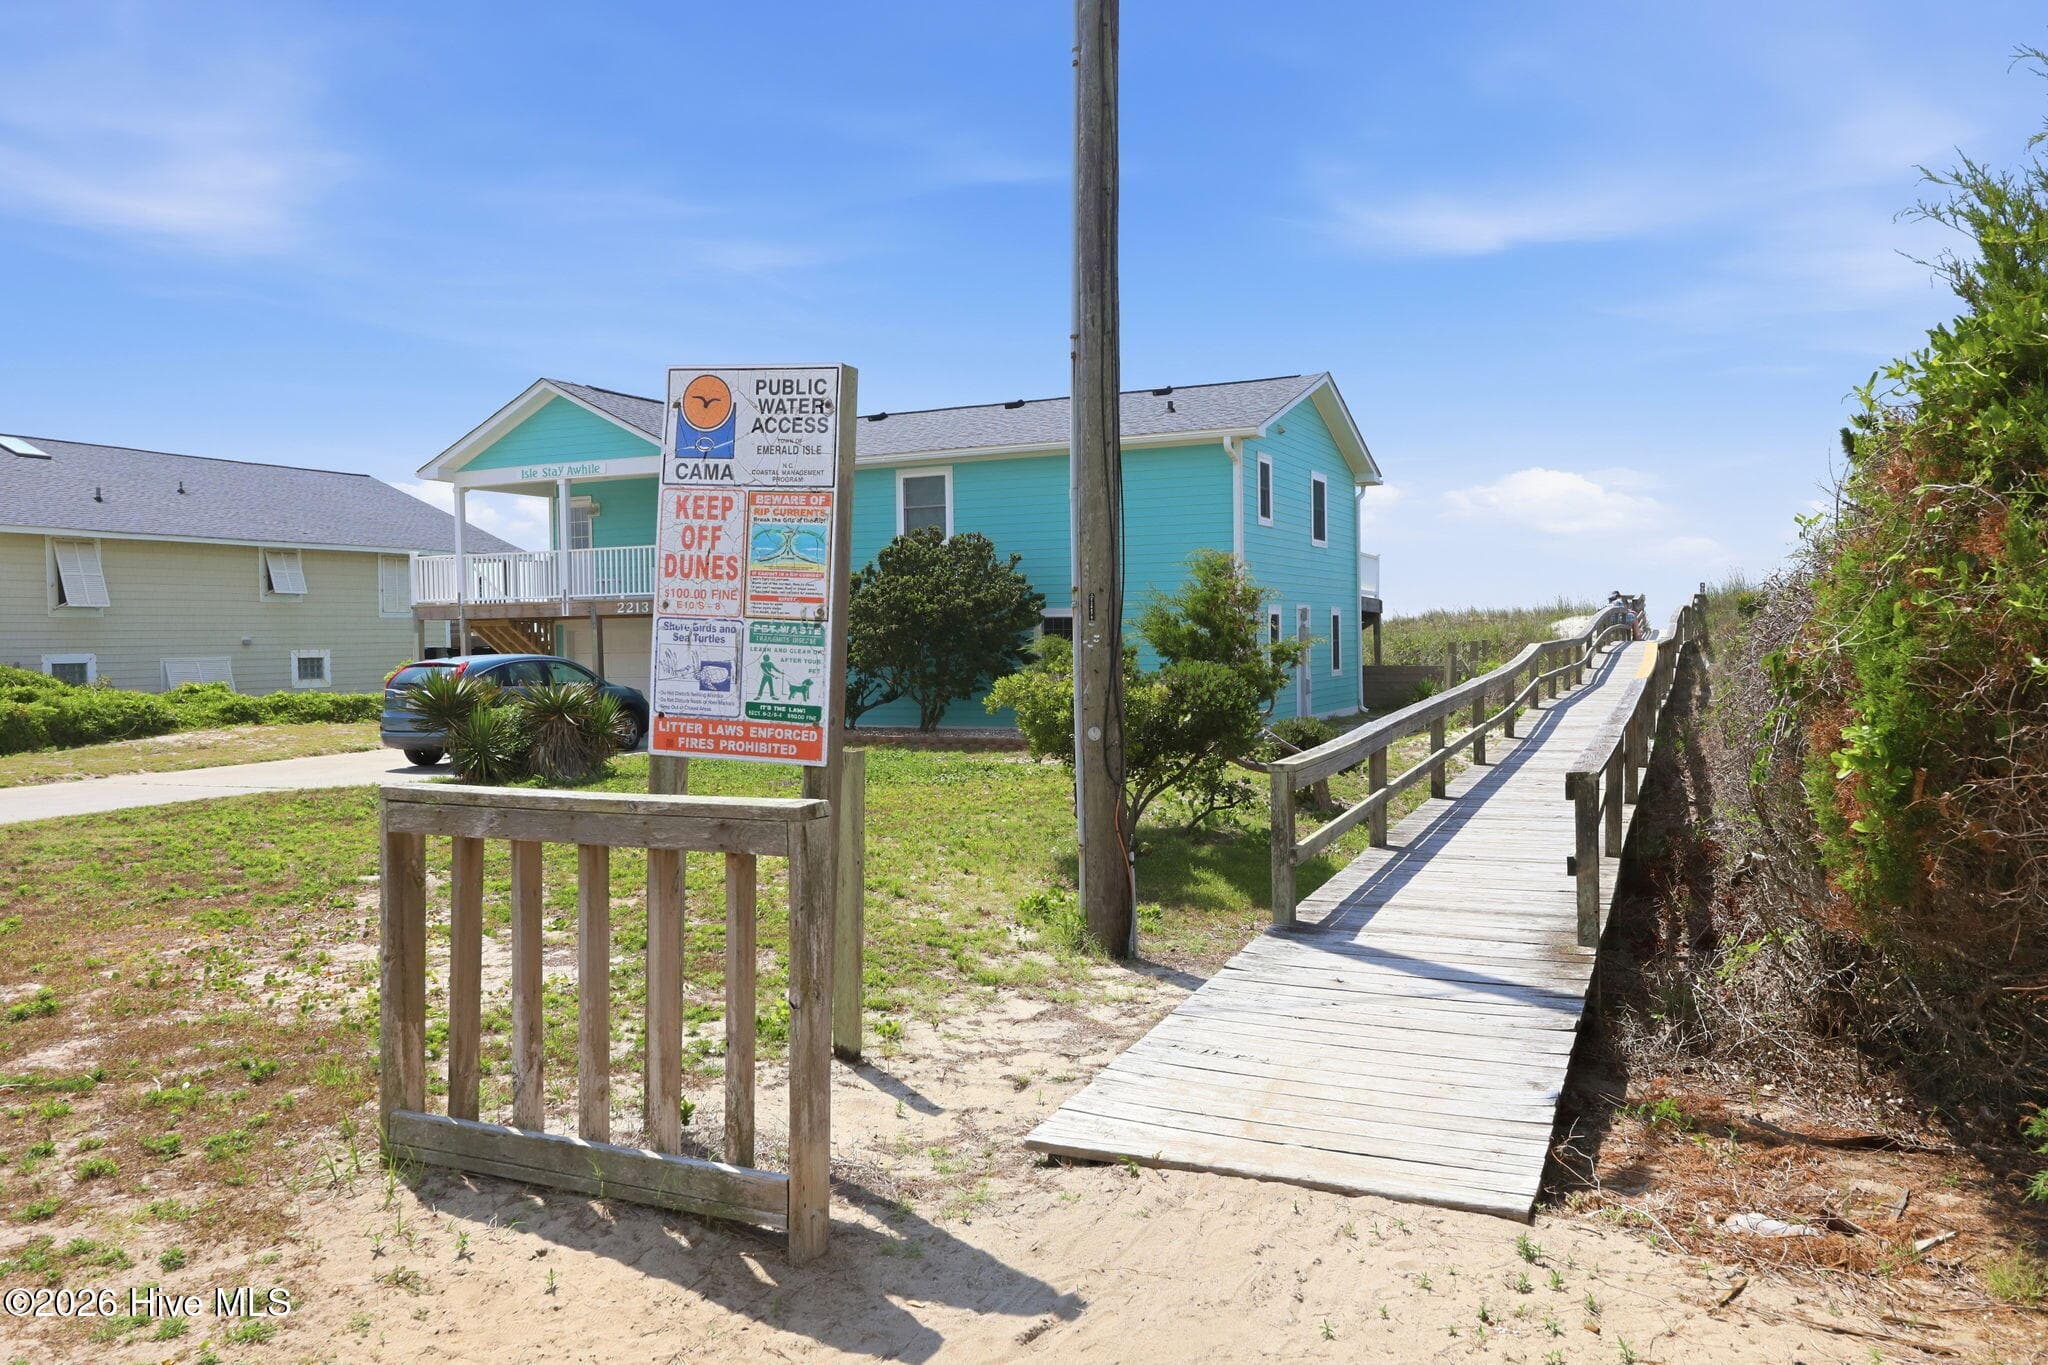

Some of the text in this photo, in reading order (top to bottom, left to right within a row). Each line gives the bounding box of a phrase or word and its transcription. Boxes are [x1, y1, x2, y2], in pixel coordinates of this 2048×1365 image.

[755, 379, 828, 396] PUBLIC
[758, 398, 825, 415] WATER
[751, 416, 829, 434] ACCESS
[757, 445, 823, 456] EMERALD ISLE
[521, 463, 601, 480] Isle Stay Awhile
[675, 463, 734, 481] CAMA
[676, 494, 733, 520] KEEP
[755, 495, 826, 505] BEWARE OF
[772, 508, 826, 517] CURRENTS
[681, 525, 722, 550] OFF
[664, 553, 738, 581] DUNES
[664, 588, 737, 600] $100.00 FINE
[617, 602, 648, 613] 2213
[663, 622, 737, 634] Shore Birds and
[778, 625, 822, 636] WASTE
[672, 633, 726, 644] Sea Turtles
[658, 721, 818, 742] LITTER LAWS ENFORCED
[678, 737, 797, 755] FIRES PROHIBITED
